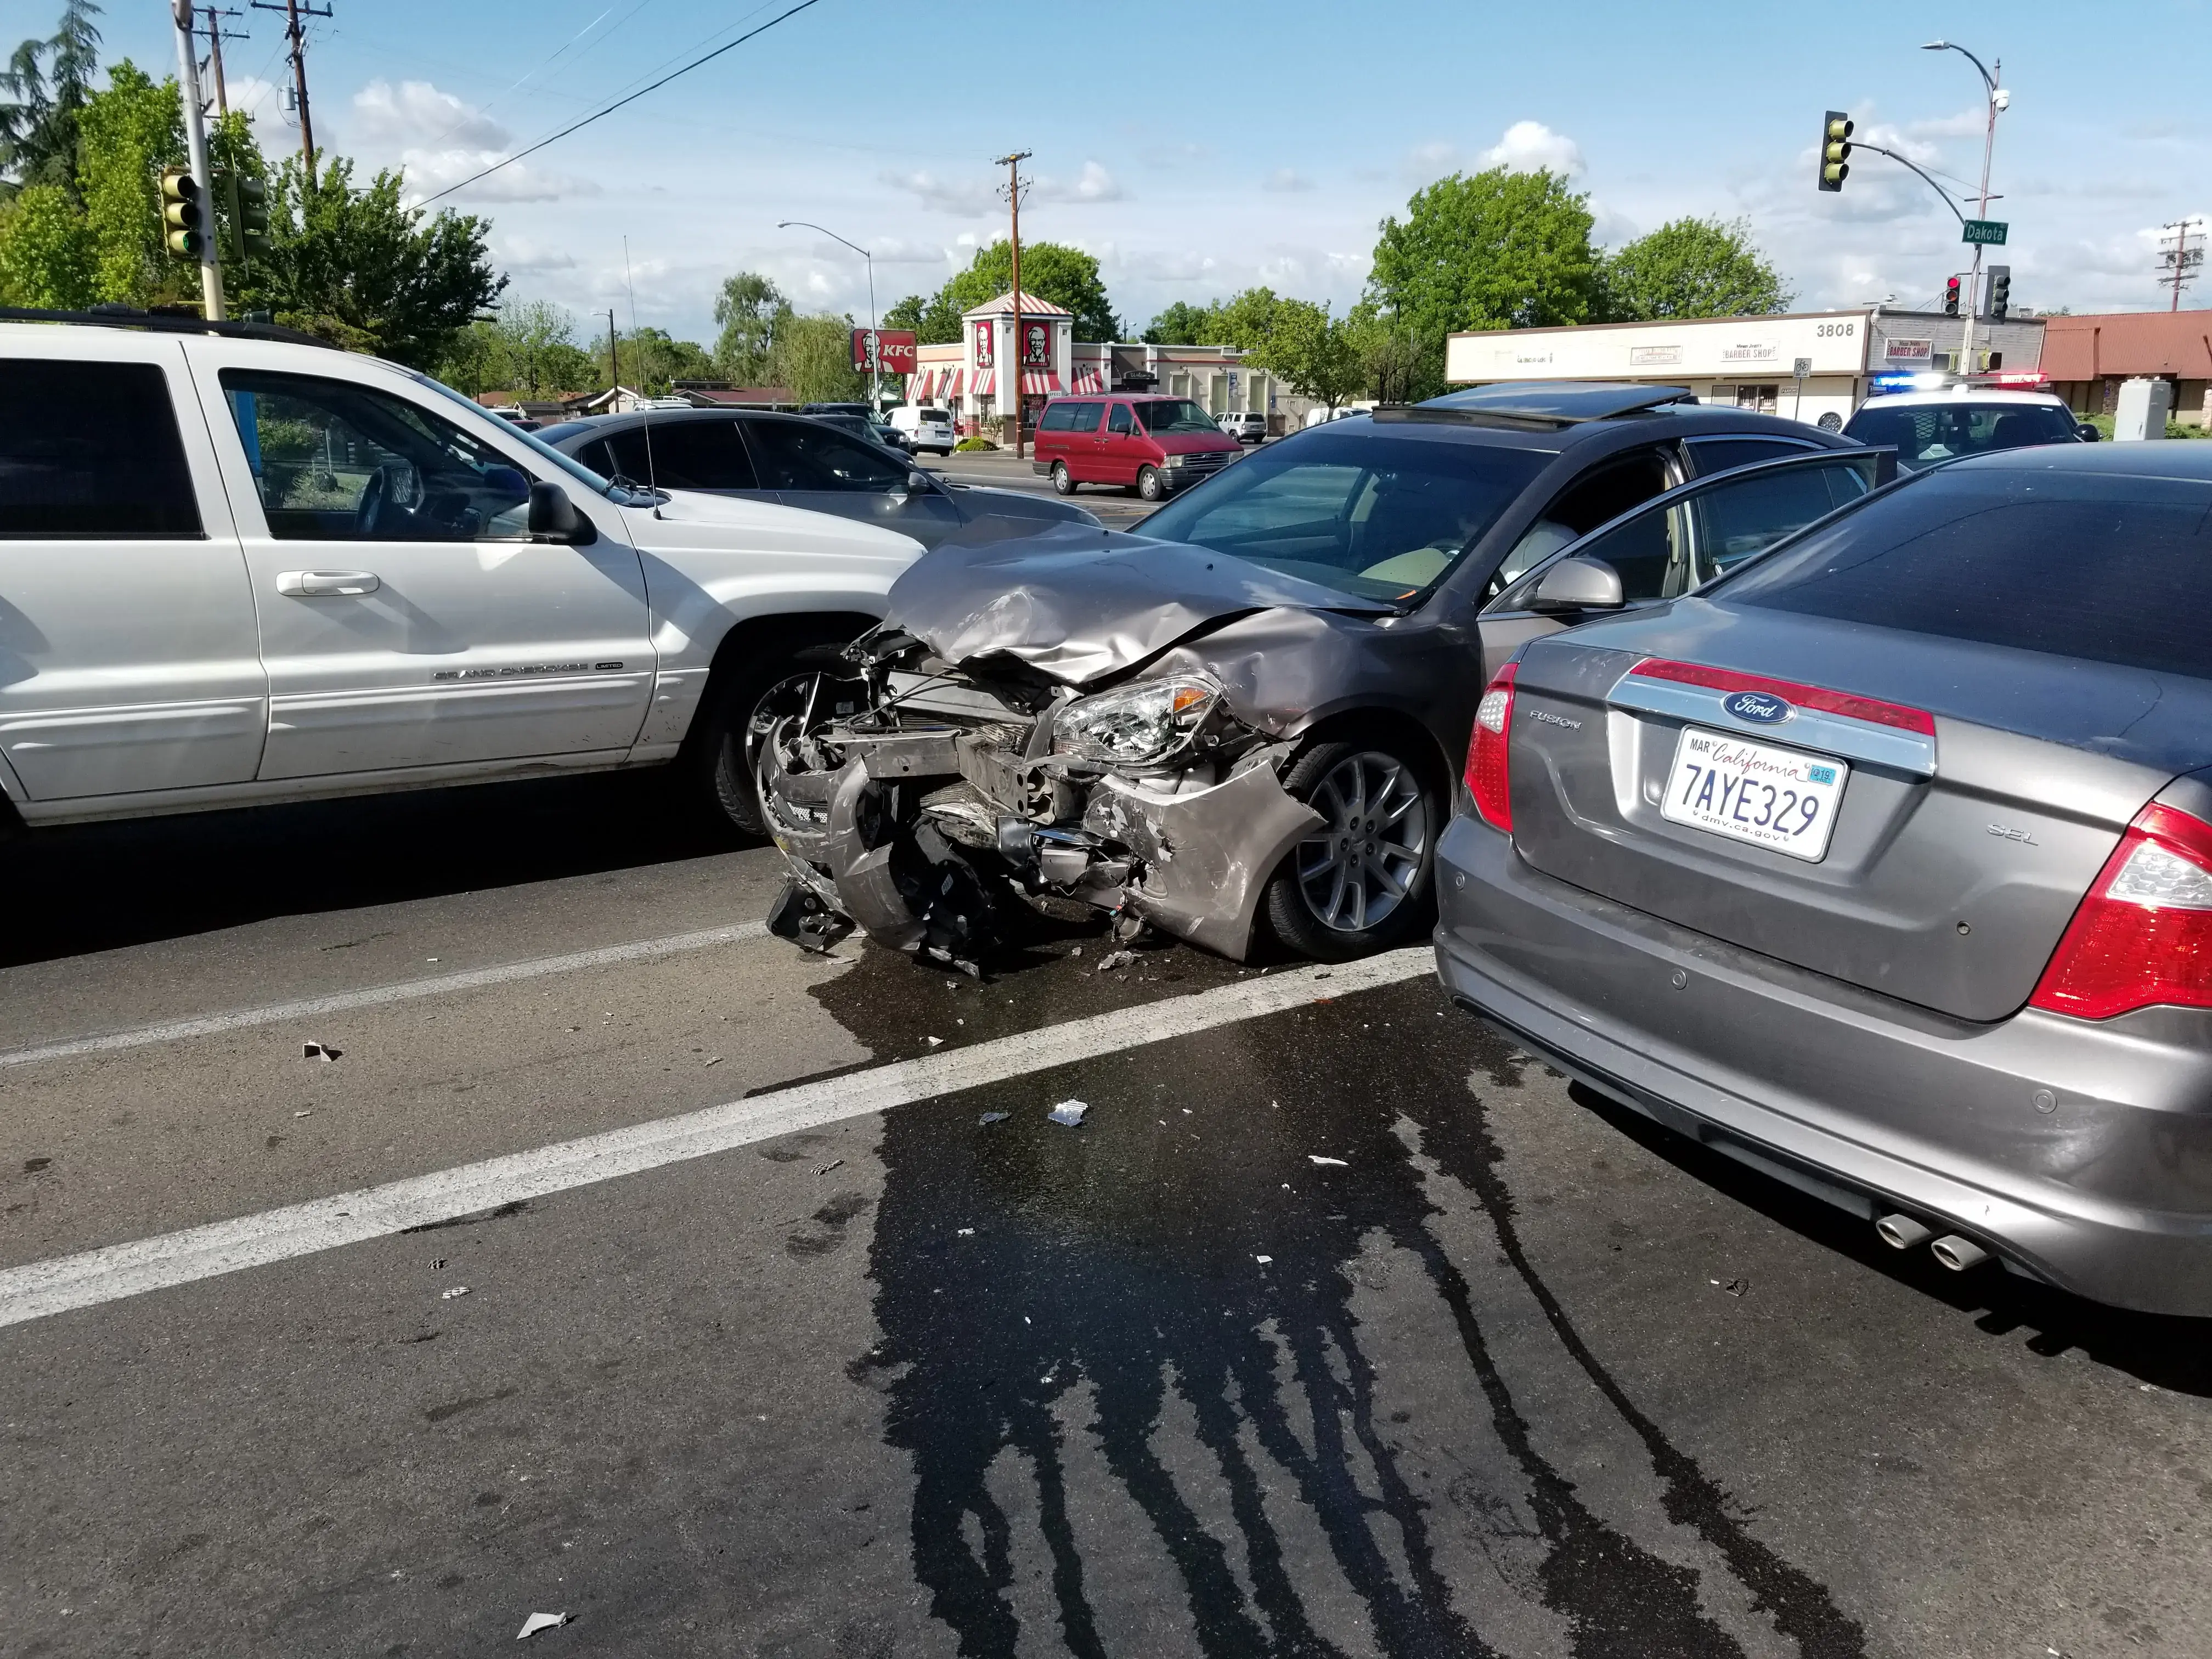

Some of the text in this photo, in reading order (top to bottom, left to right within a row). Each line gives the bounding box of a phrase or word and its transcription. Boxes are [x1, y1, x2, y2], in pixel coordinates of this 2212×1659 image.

[1967, 224, 2003, 241] Dakota
[1817, 324, 1854, 337] 3808
[883, 345, 913, 357] KFC
[1725, 348, 1772, 358] BARBER SHOP
[1889, 347, 1928, 357] BARBER SHOP
[433, 669, 496, 680] GRAND
[499, 663, 588, 675] CHEROKEE
[1734, 695, 1778, 717] Ford
[1530, 710, 1582, 731] FUSION
[1690, 738, 1711, 753] MAR
[1712, 743, 1808, 782] California
[1821, 770, 1830, 780] 19
[1682, 763, 1820, 836] 7AYE329
[1701, 814, 1780, 841] dmv.ca.gov
[1986, 823, 2039, 846] SEL
